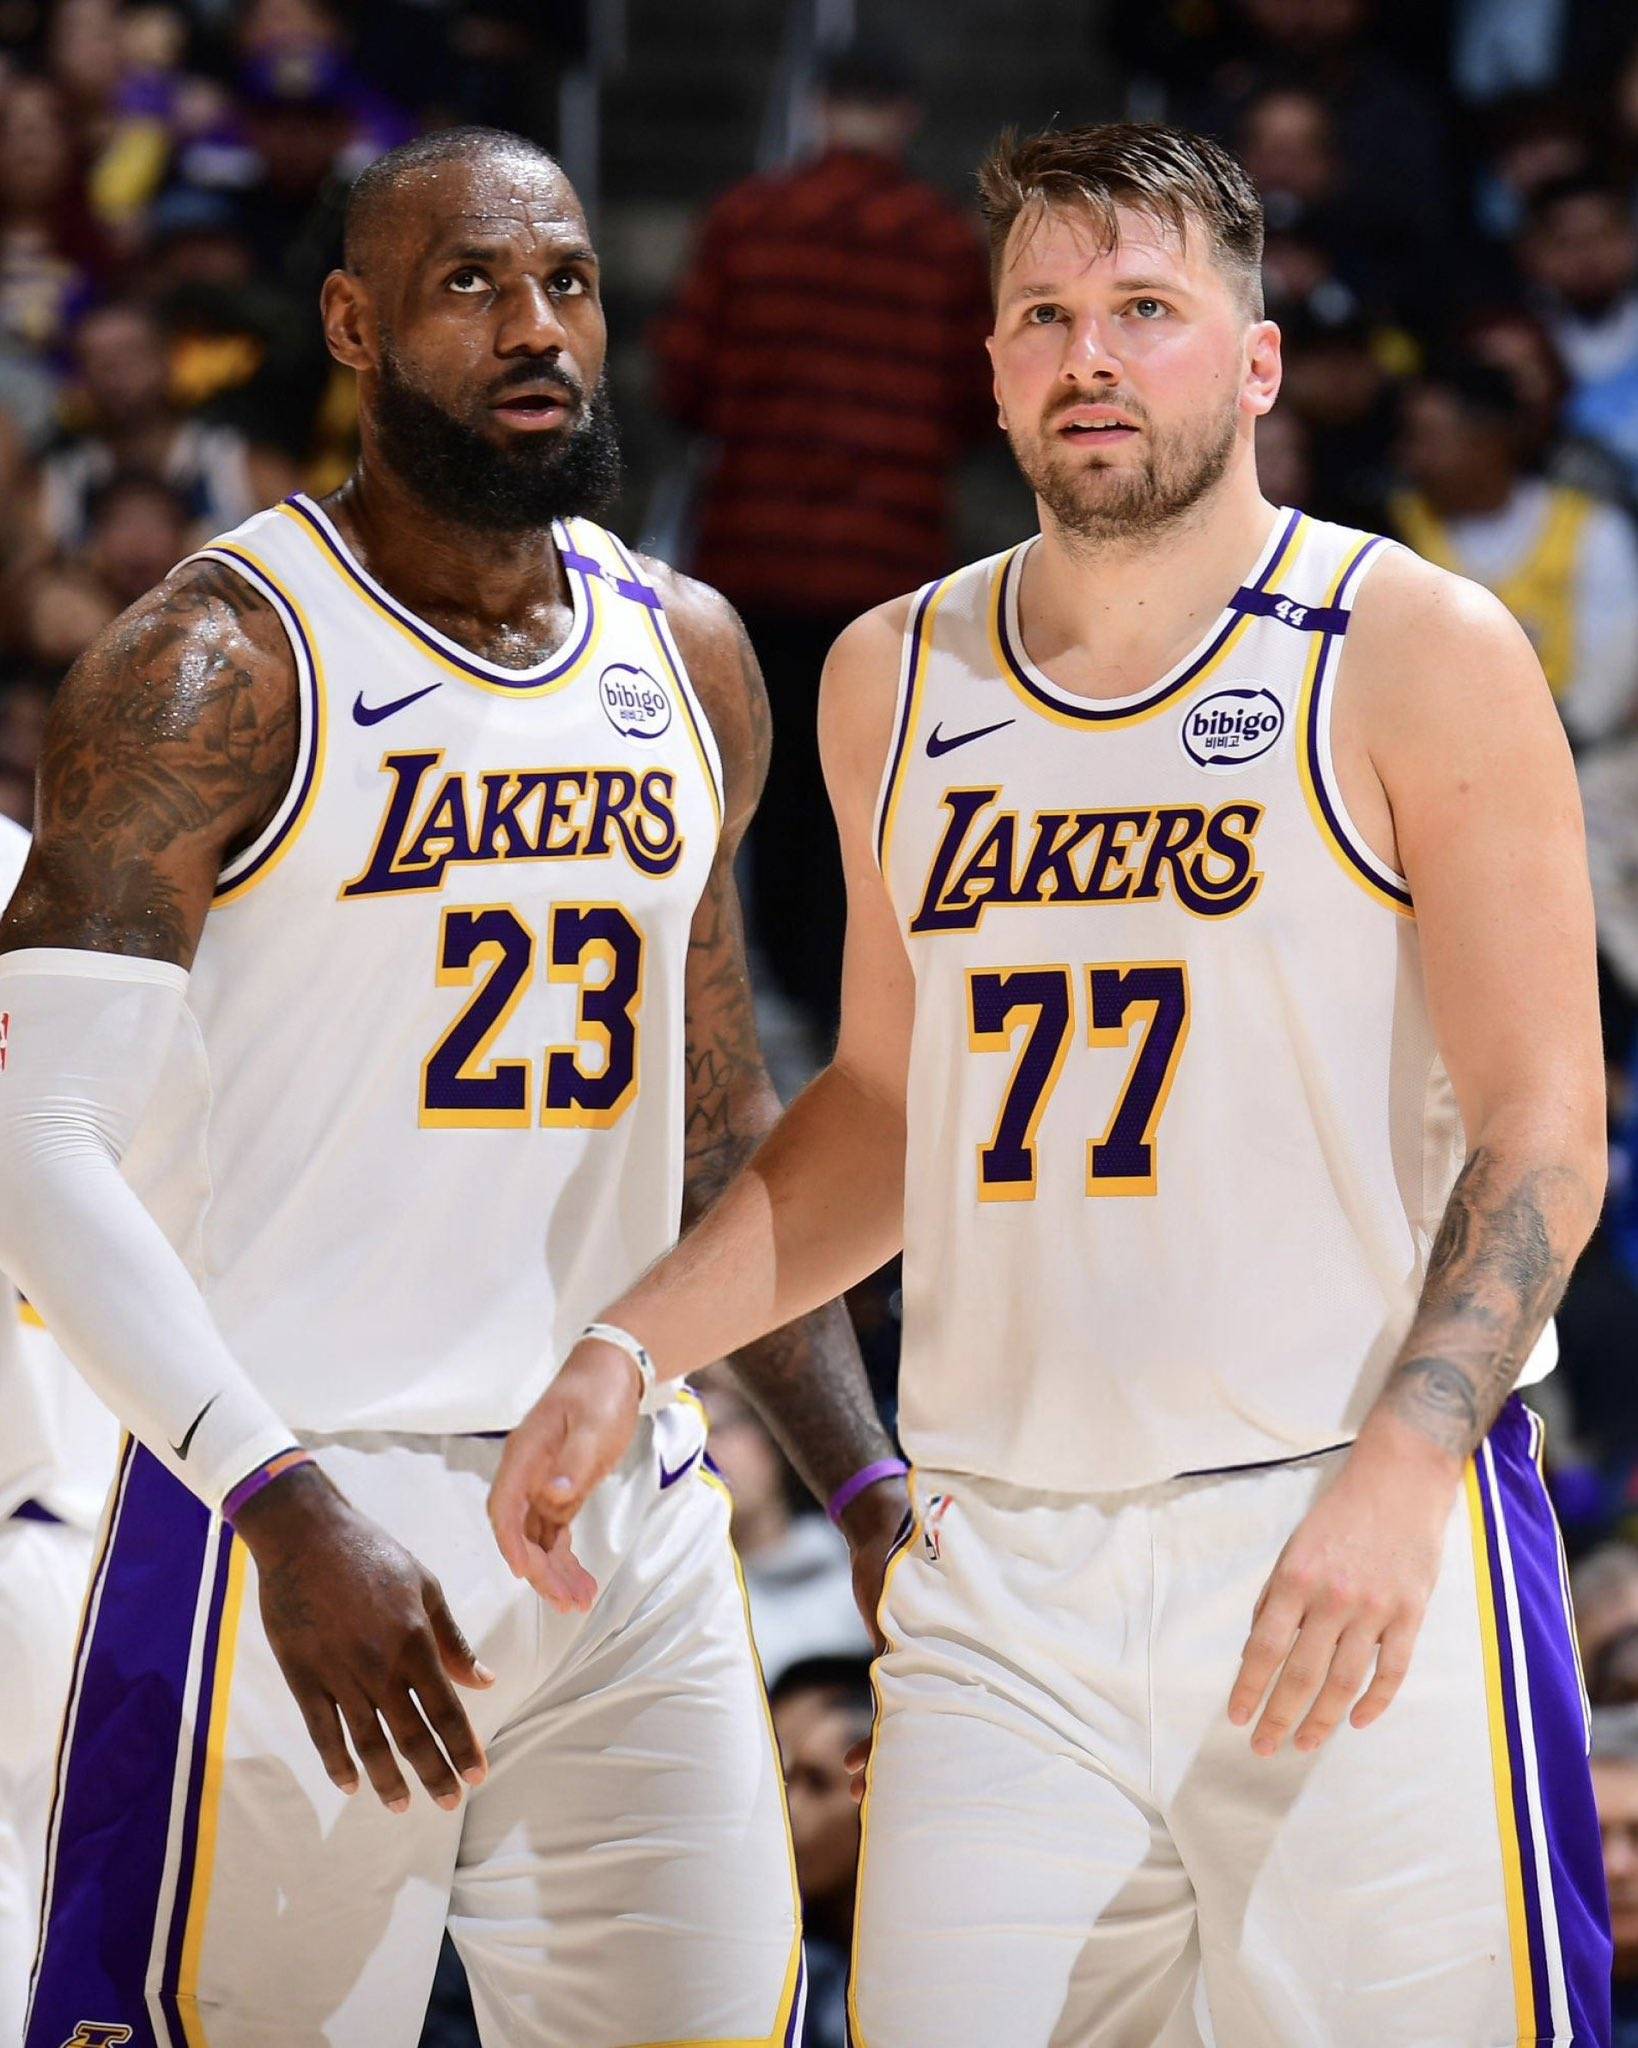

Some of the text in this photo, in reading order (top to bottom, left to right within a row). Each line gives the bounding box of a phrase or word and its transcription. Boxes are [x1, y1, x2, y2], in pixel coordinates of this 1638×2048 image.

[1274, 599, 1308, 626] 44
[604, 681, 665, 718] bibigo
[1192, 708, 1278, 741] bibigo
[1205, 735, 1240, 749] 비비고
[336, 748, 685, 901] LAKERS
[908, 784, 1267, 938] LAKERS
[418, 901, 648, 1130] 23
[963, 959, 1192, 1203] 77
